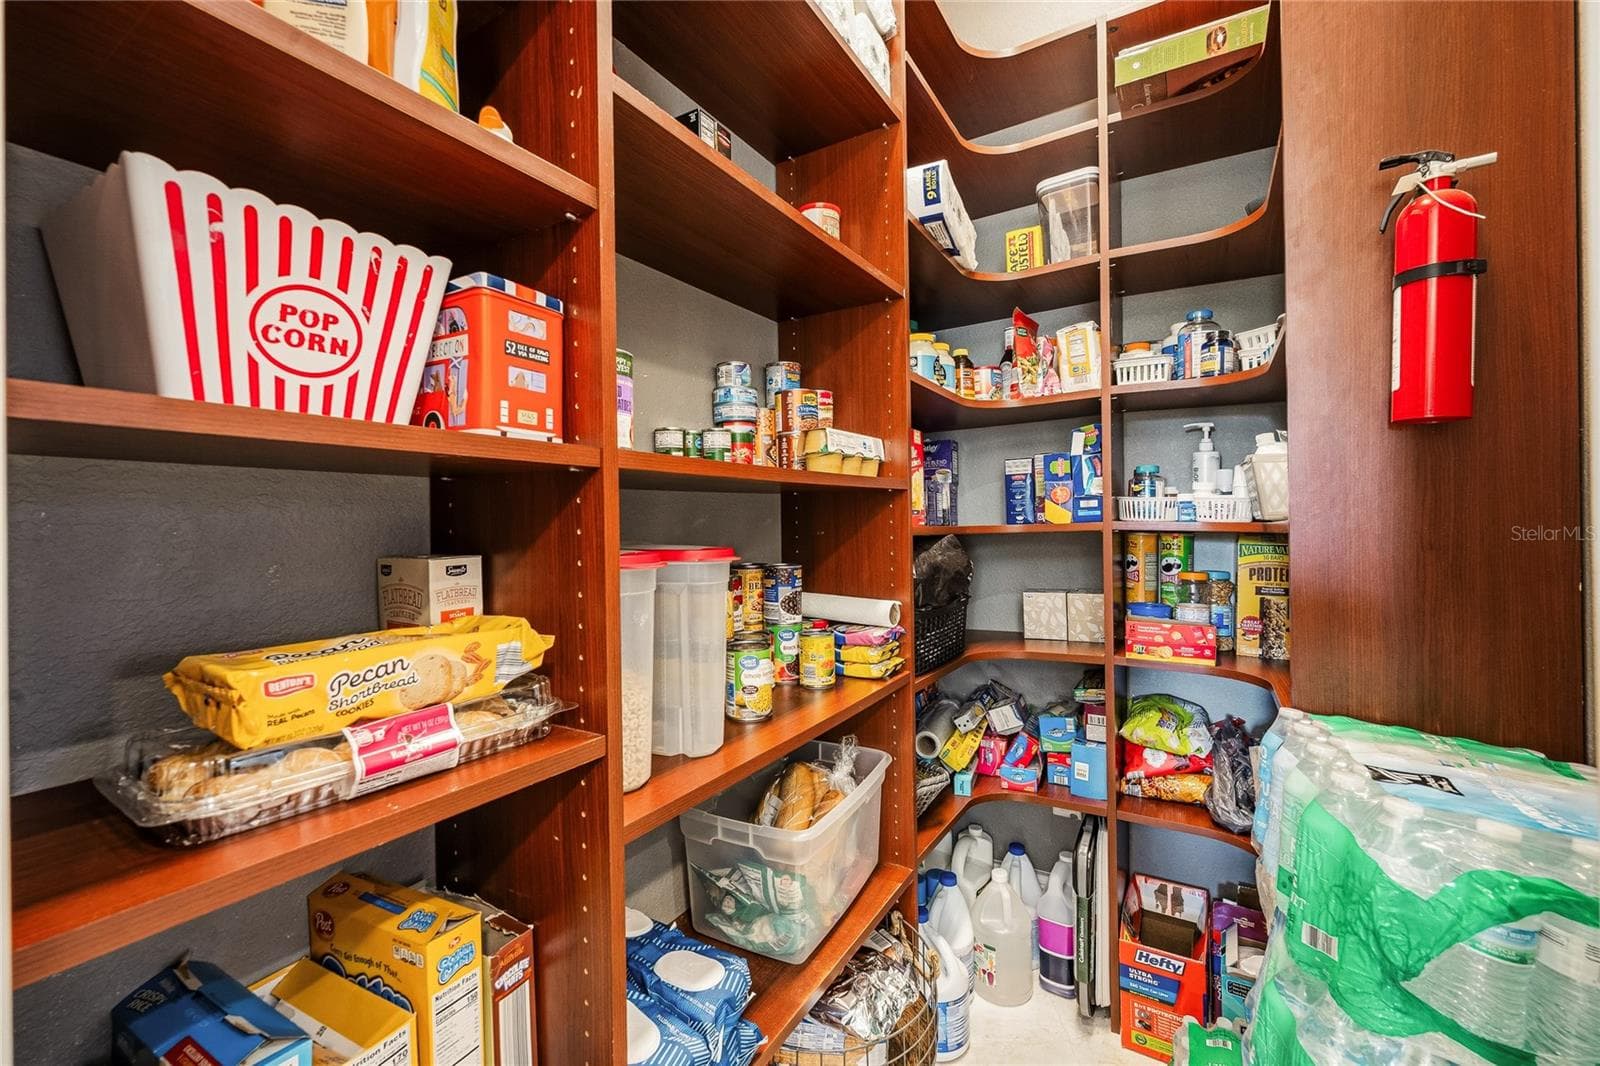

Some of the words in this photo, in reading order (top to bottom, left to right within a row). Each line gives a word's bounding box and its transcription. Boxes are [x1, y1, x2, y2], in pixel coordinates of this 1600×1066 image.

[927, 191, 936, 200] 9
[1018, 233, 1028, 271] USTELO
[279, 303, 339, 331] POP
[261, 324, 348, 357] CORN
[505, 341, 516, 354] 52
[1241, 545, 1275, 557] NATURE
[382, 587, 423, 609] FLATBREAD
[436, 587, 478, 602] FLATBREAD
[329, 657, 410, 697] Pecan
[328, 672, 418, 711] Shortbread
[335, 698, 375, 717] COOKIES
[266, 717, 288, 727] REAL
[315, 912, 332, 931] Post
[353, 953, 375, 969] Enough
[1138, 951, 1182, 974] Hefty
[1128, 967, 1152, 979] ULTRA
[1128, 973, 1159, 986] STRONG
[435, 982, 460, 1001] Nutrition
[462, 972, 477, 986] Facts
[1146, 1006, 1184, 1023] PROTECTIO
[383, 1029, 407, 1049] Facts
